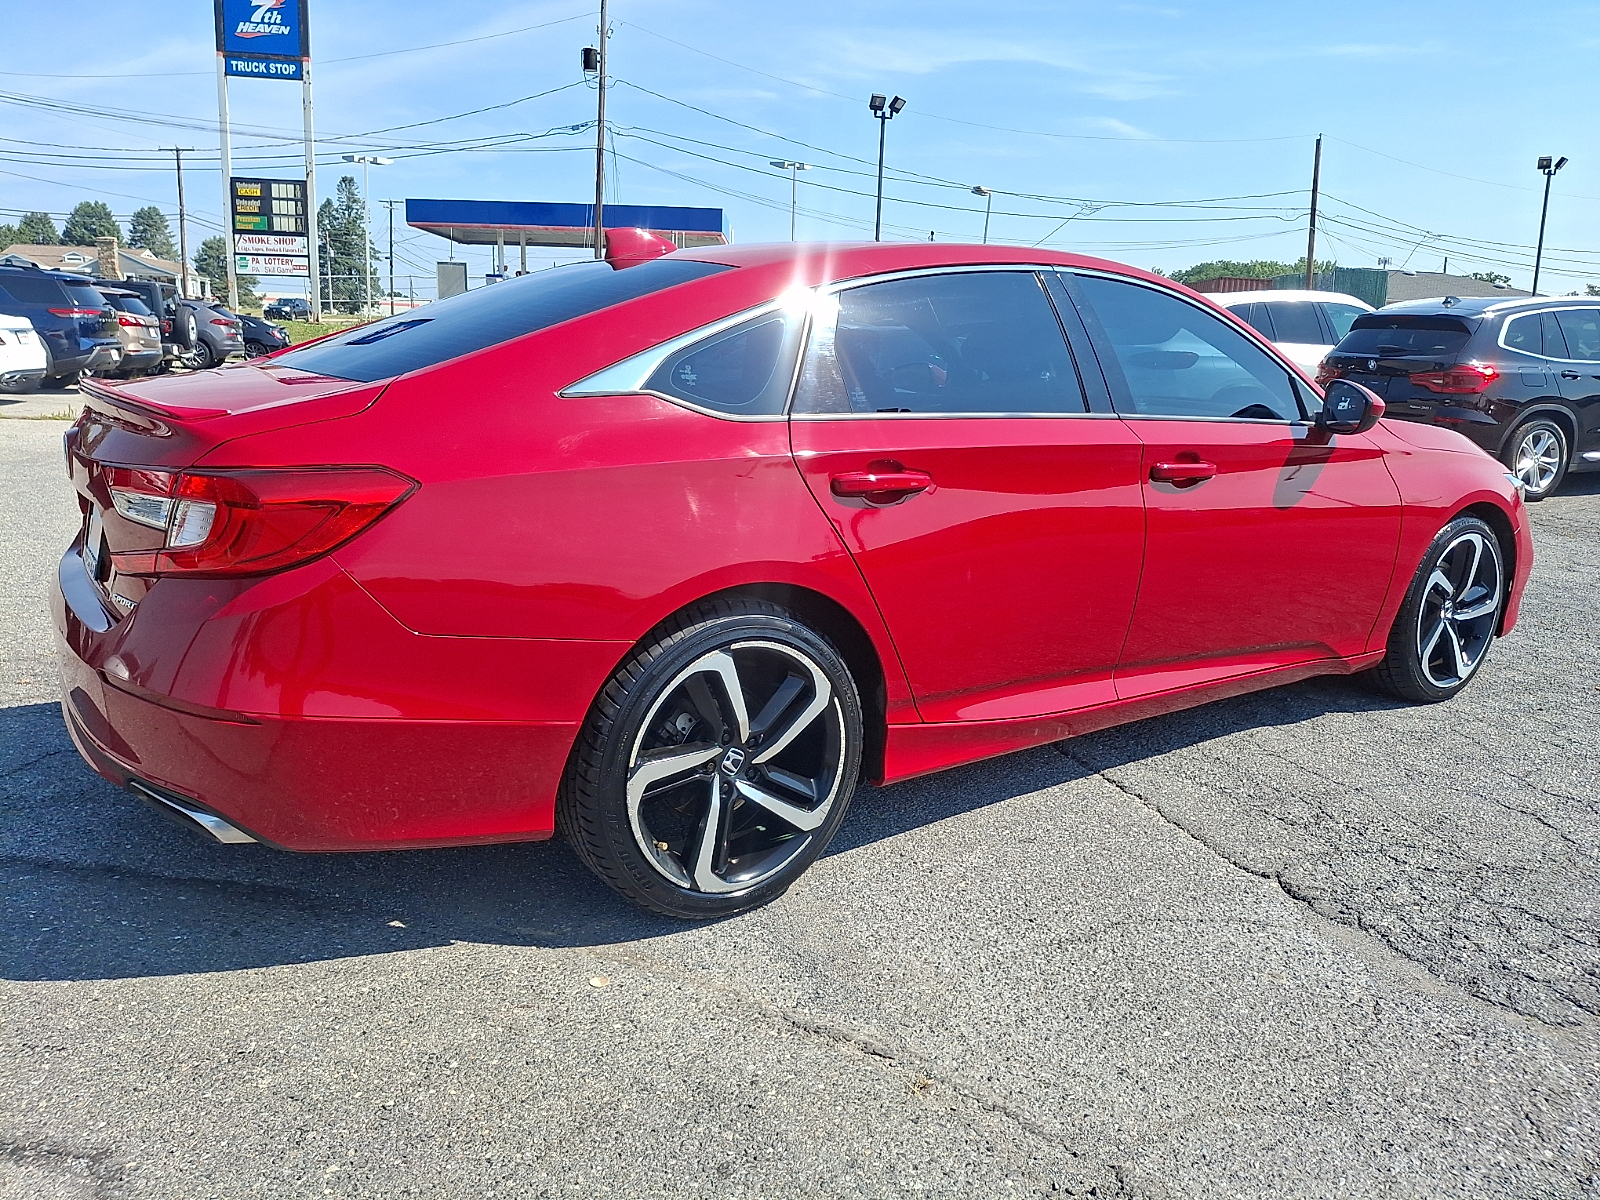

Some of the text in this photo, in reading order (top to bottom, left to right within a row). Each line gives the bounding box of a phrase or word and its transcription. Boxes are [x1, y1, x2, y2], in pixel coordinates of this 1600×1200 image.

[250, 0, 282, 24] 7th
[236, 22, 291, 35] HEAVEN
[230, 60, 297, 75] TRUCK STOP
[236, 182, 261, 190] Unleaded
[242, 236, 297, 246] SMOKE SHOP
[251, 257, 294, 265] PA LOTTERY
[112, 593, 138, 610] SPORT
